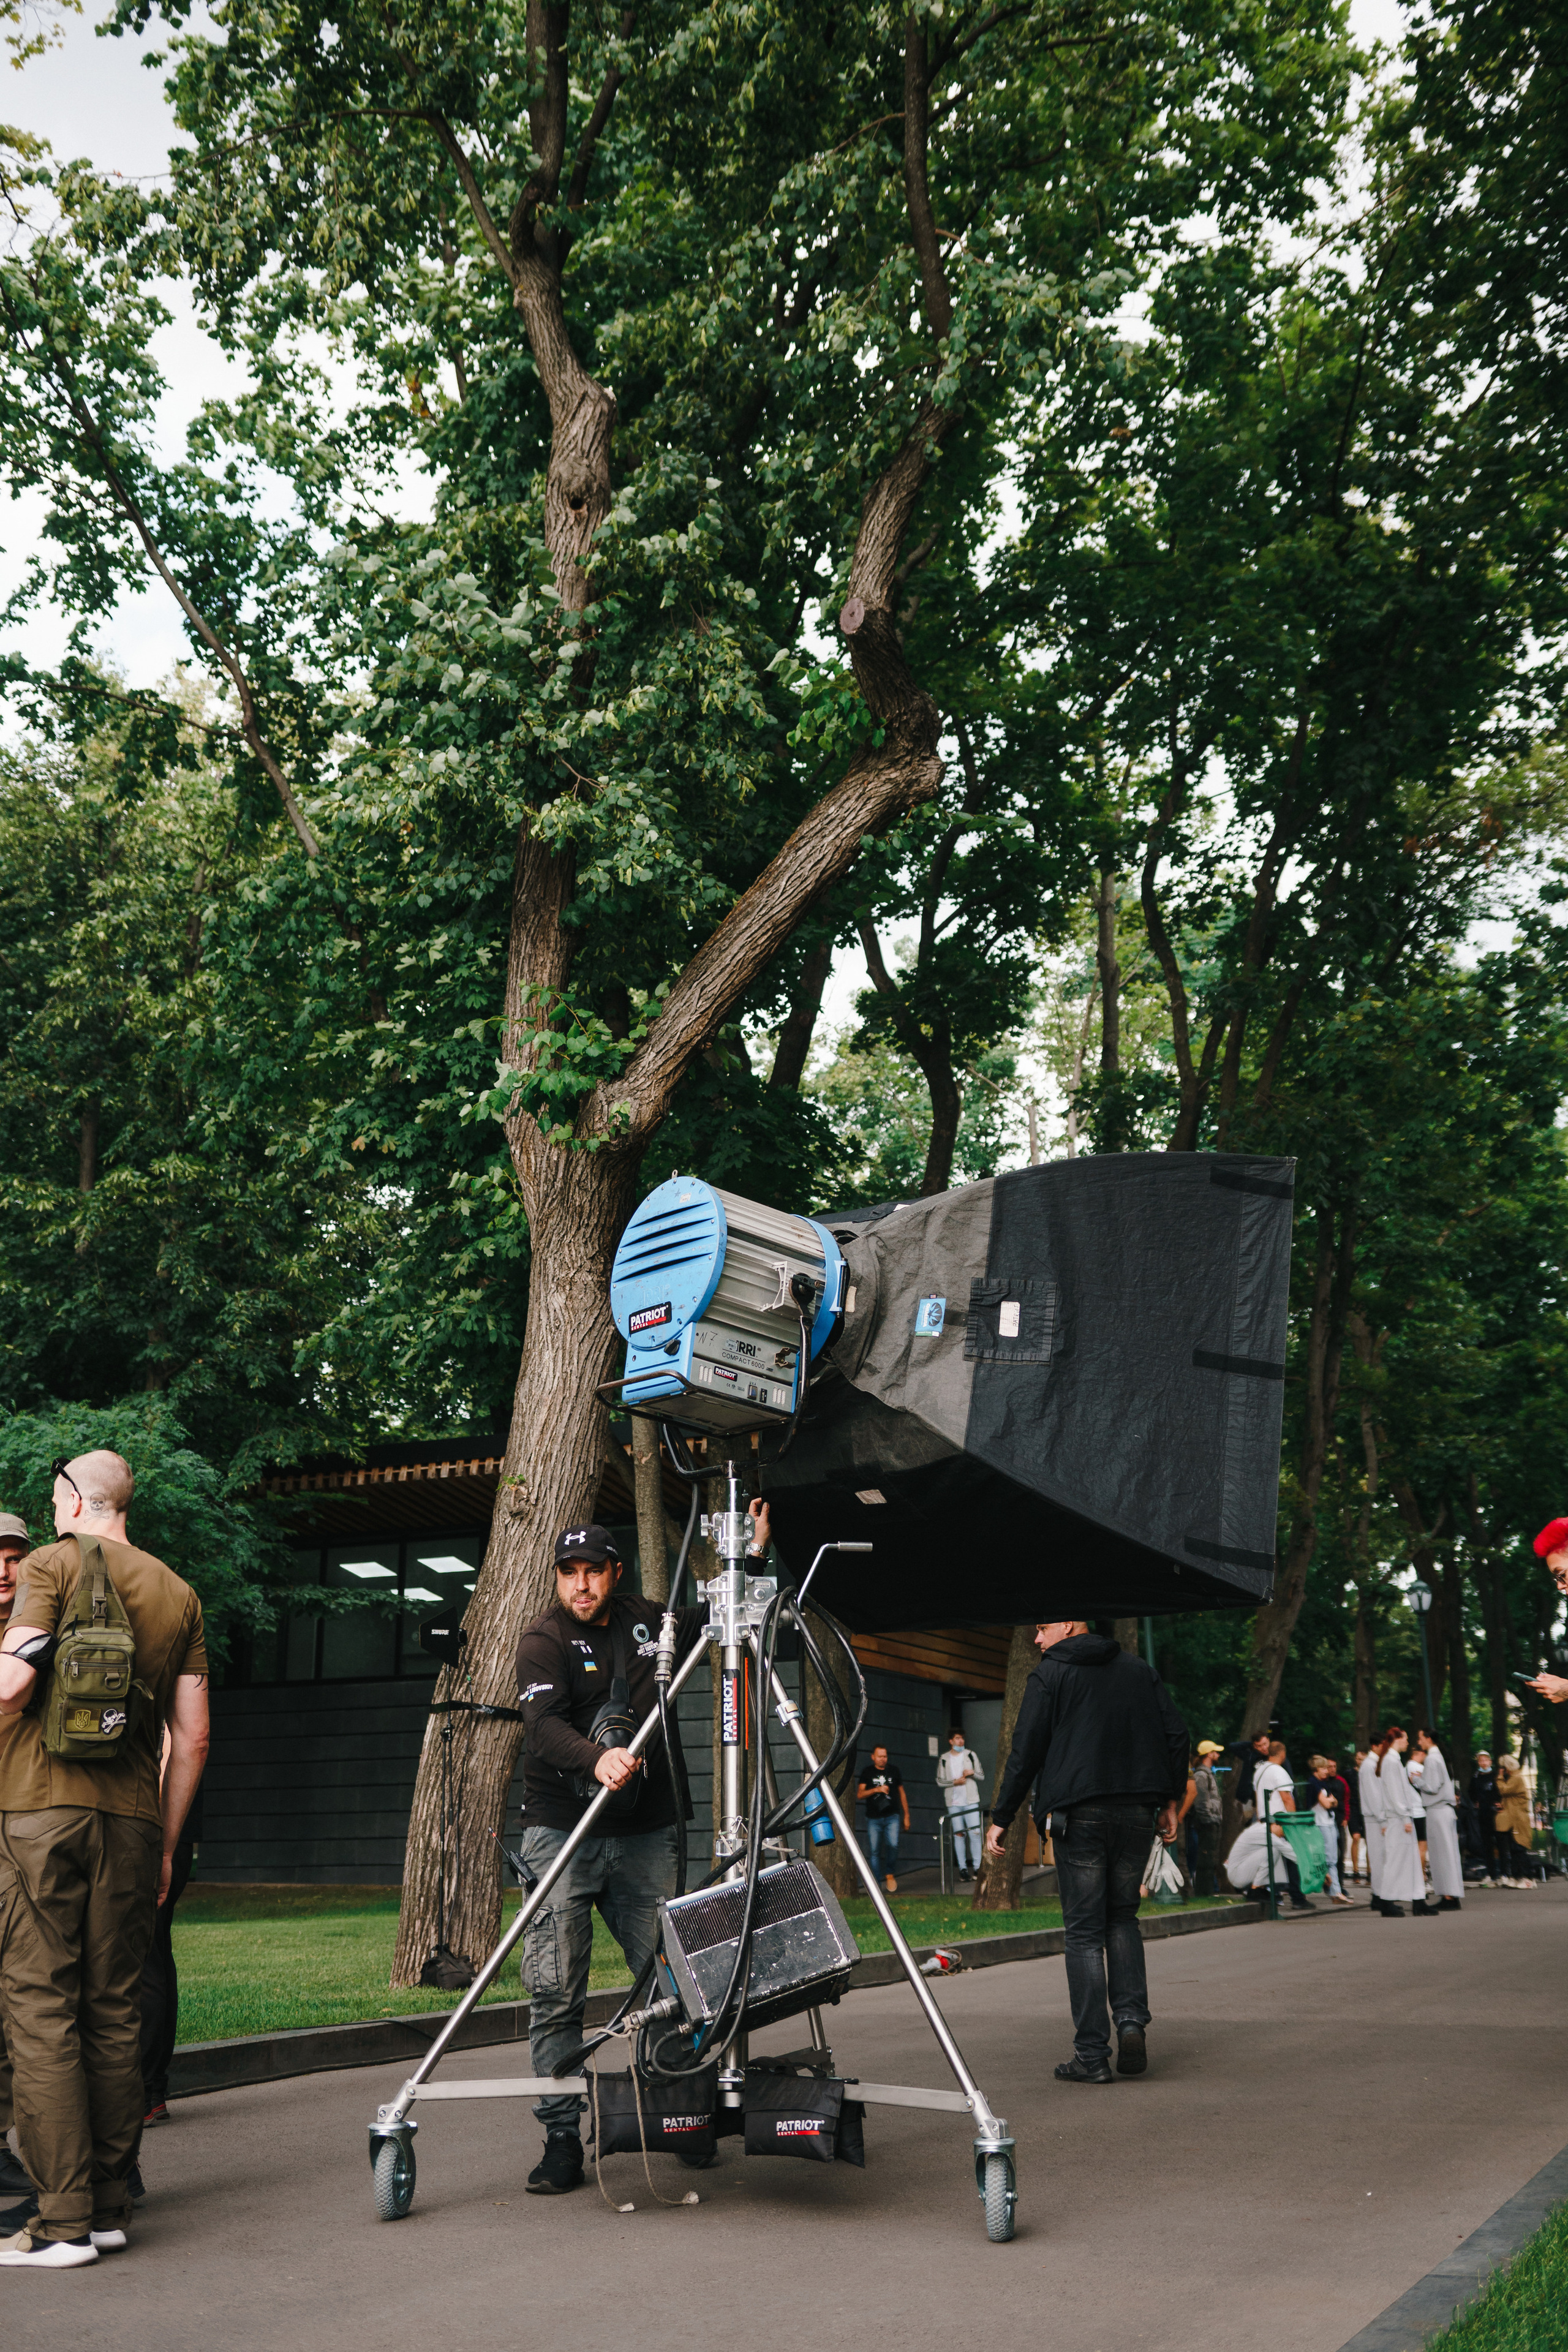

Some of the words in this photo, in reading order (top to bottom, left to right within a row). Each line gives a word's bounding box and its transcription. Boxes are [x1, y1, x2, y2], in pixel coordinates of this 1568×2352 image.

[630, 1306, 666, 1327] PATRIOT
[722, 1352, 750, 1365] COMPACT
[751, 1360, 765, 1370] 6000
[715, 1368, 736, 1378] PATRIOT
[723, 1678, 733, 1741] PATRIOT
[663, 2115, 709, 2128] PATRIOT
[776, 2119, 821, 2132] PATRIOT
